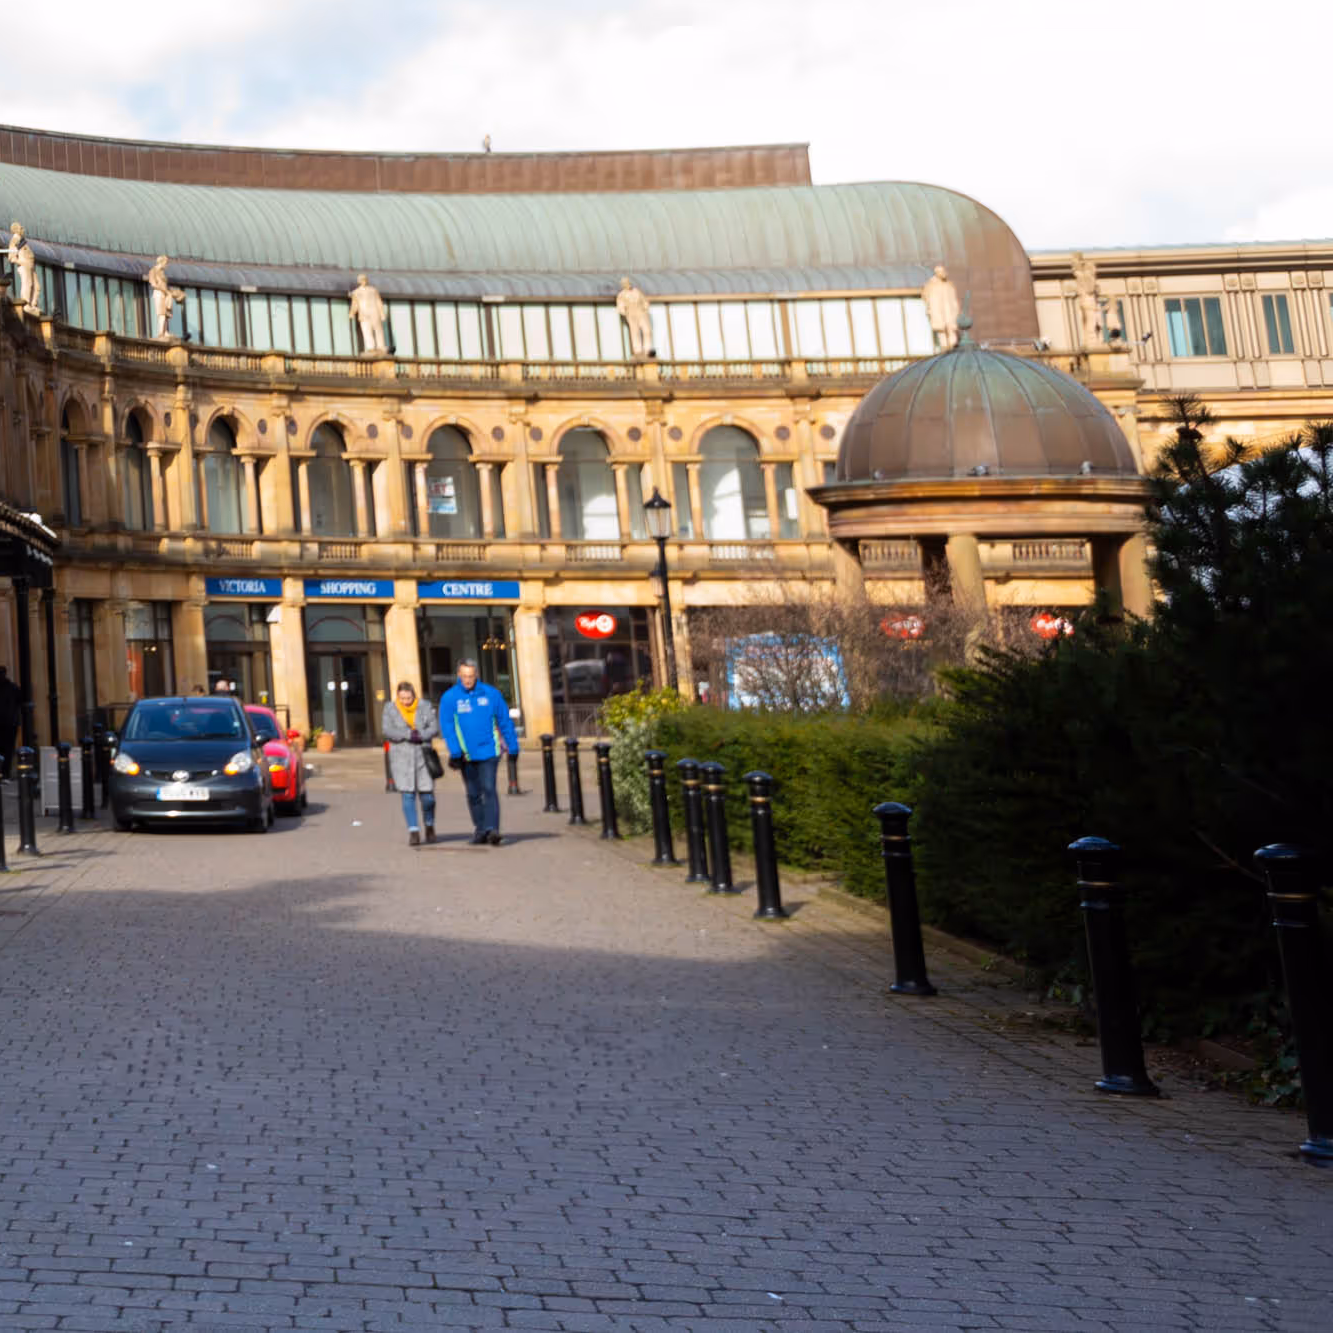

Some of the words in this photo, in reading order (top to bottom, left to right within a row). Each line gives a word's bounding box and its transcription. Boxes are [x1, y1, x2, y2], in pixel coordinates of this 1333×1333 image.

[219, 579, 266, 594] VICTORIA
[320, 582, 376, 595] SHOPPING
[442, 582, 493, 596] CENTRE
